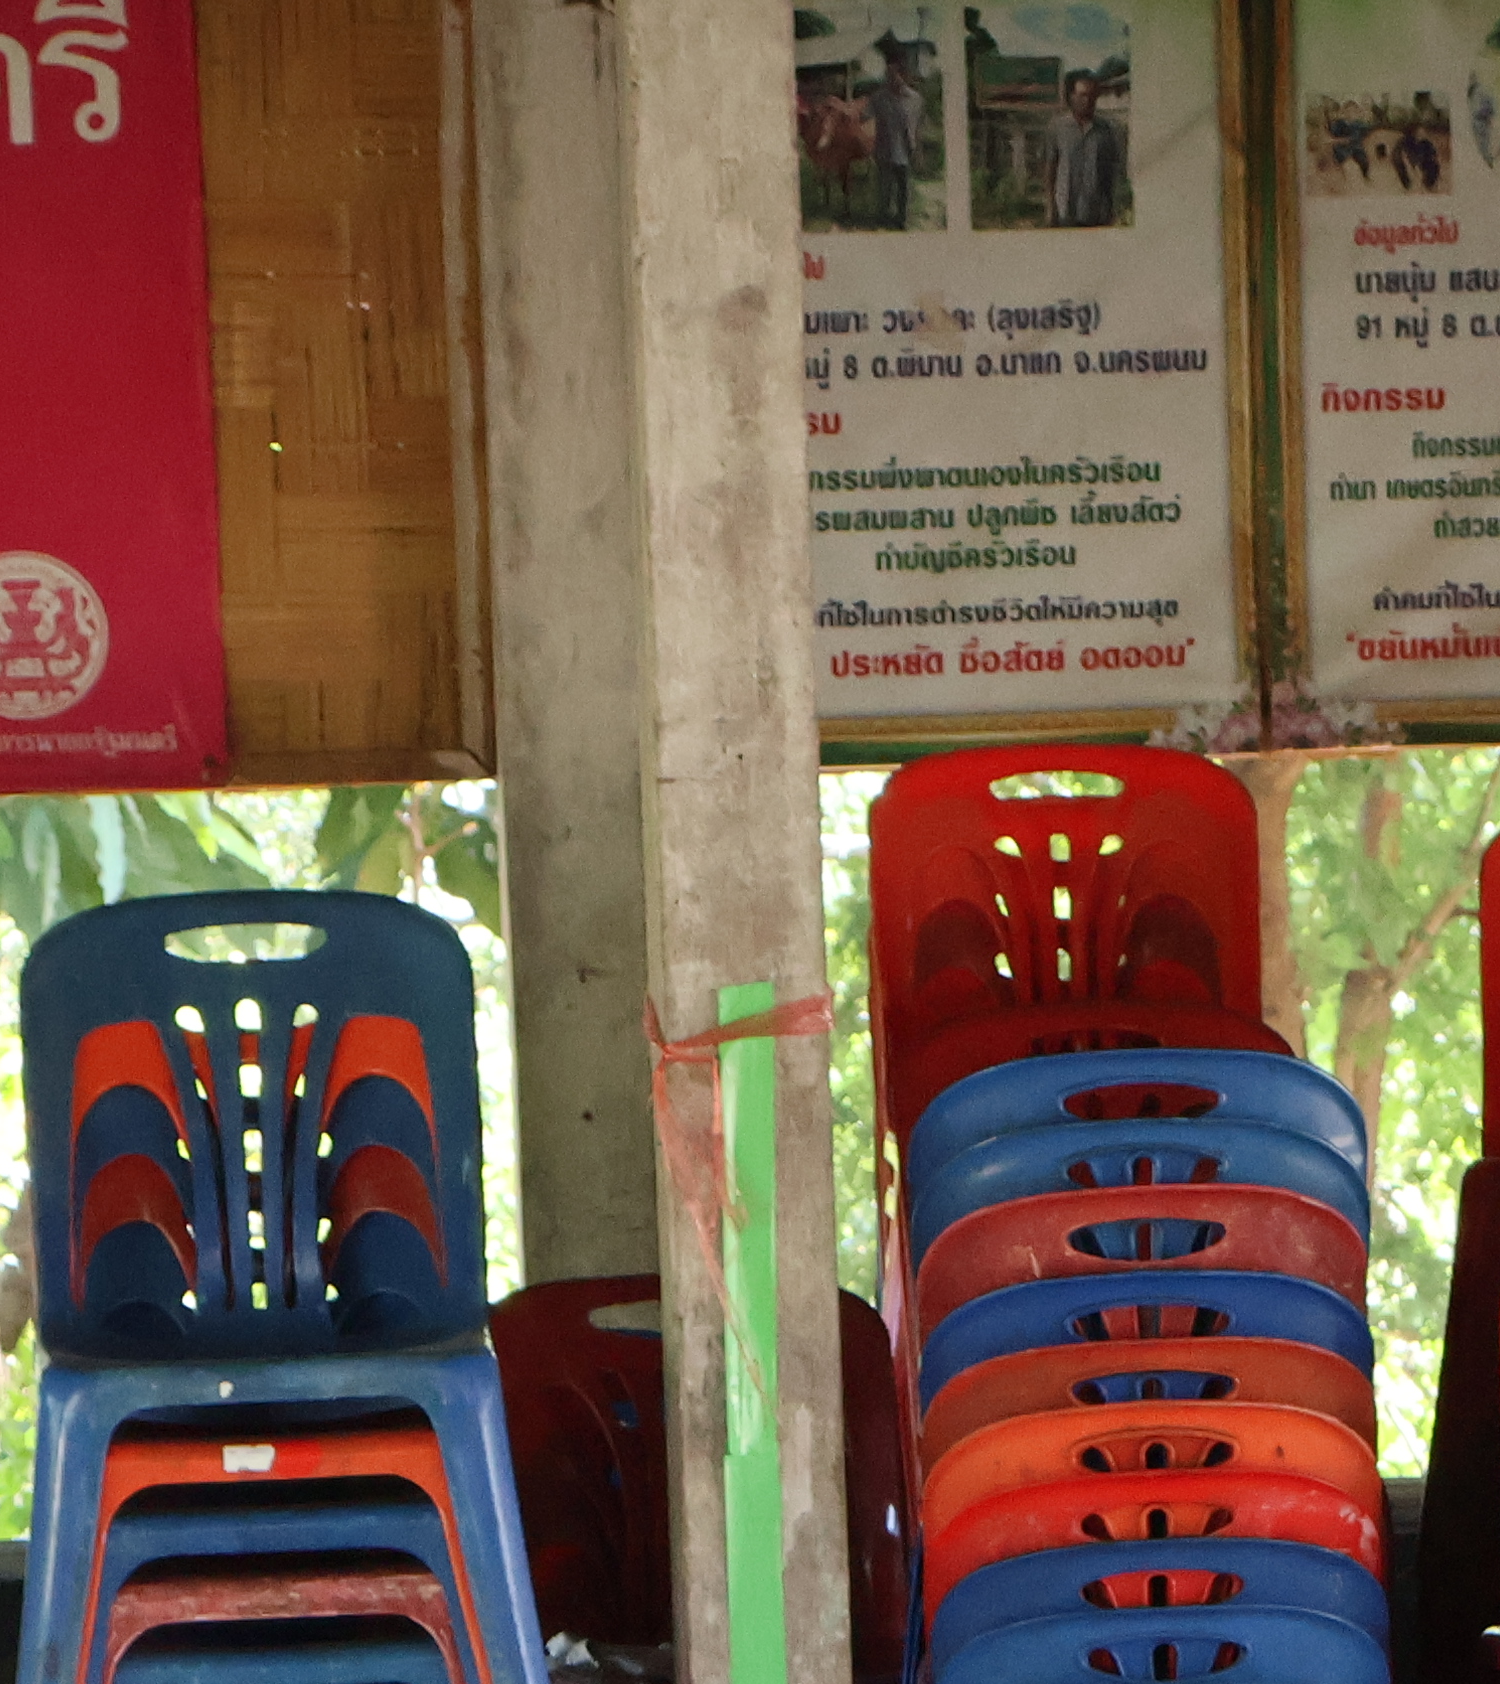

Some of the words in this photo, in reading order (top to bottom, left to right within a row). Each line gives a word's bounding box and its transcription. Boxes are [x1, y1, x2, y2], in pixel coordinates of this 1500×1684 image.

[1356, 314, 1383, 340] 91
[1395, 307, 1429, 348] หมู่
[872, 348, 963, 378] ต.พิมาน
[976, 352, 1062, 377] อ.นาแก
[1076, 348, 1208, 375] จ.นครพนม
[1322, 381, 1446, 413] กิจกรรม
[876, 540, 1077, 574] ทำบัญชีครัวเรือน
[831, 644, 944, 679] ประหยัด
[960, 637, 1065, 674] ซื่อสัตย์
